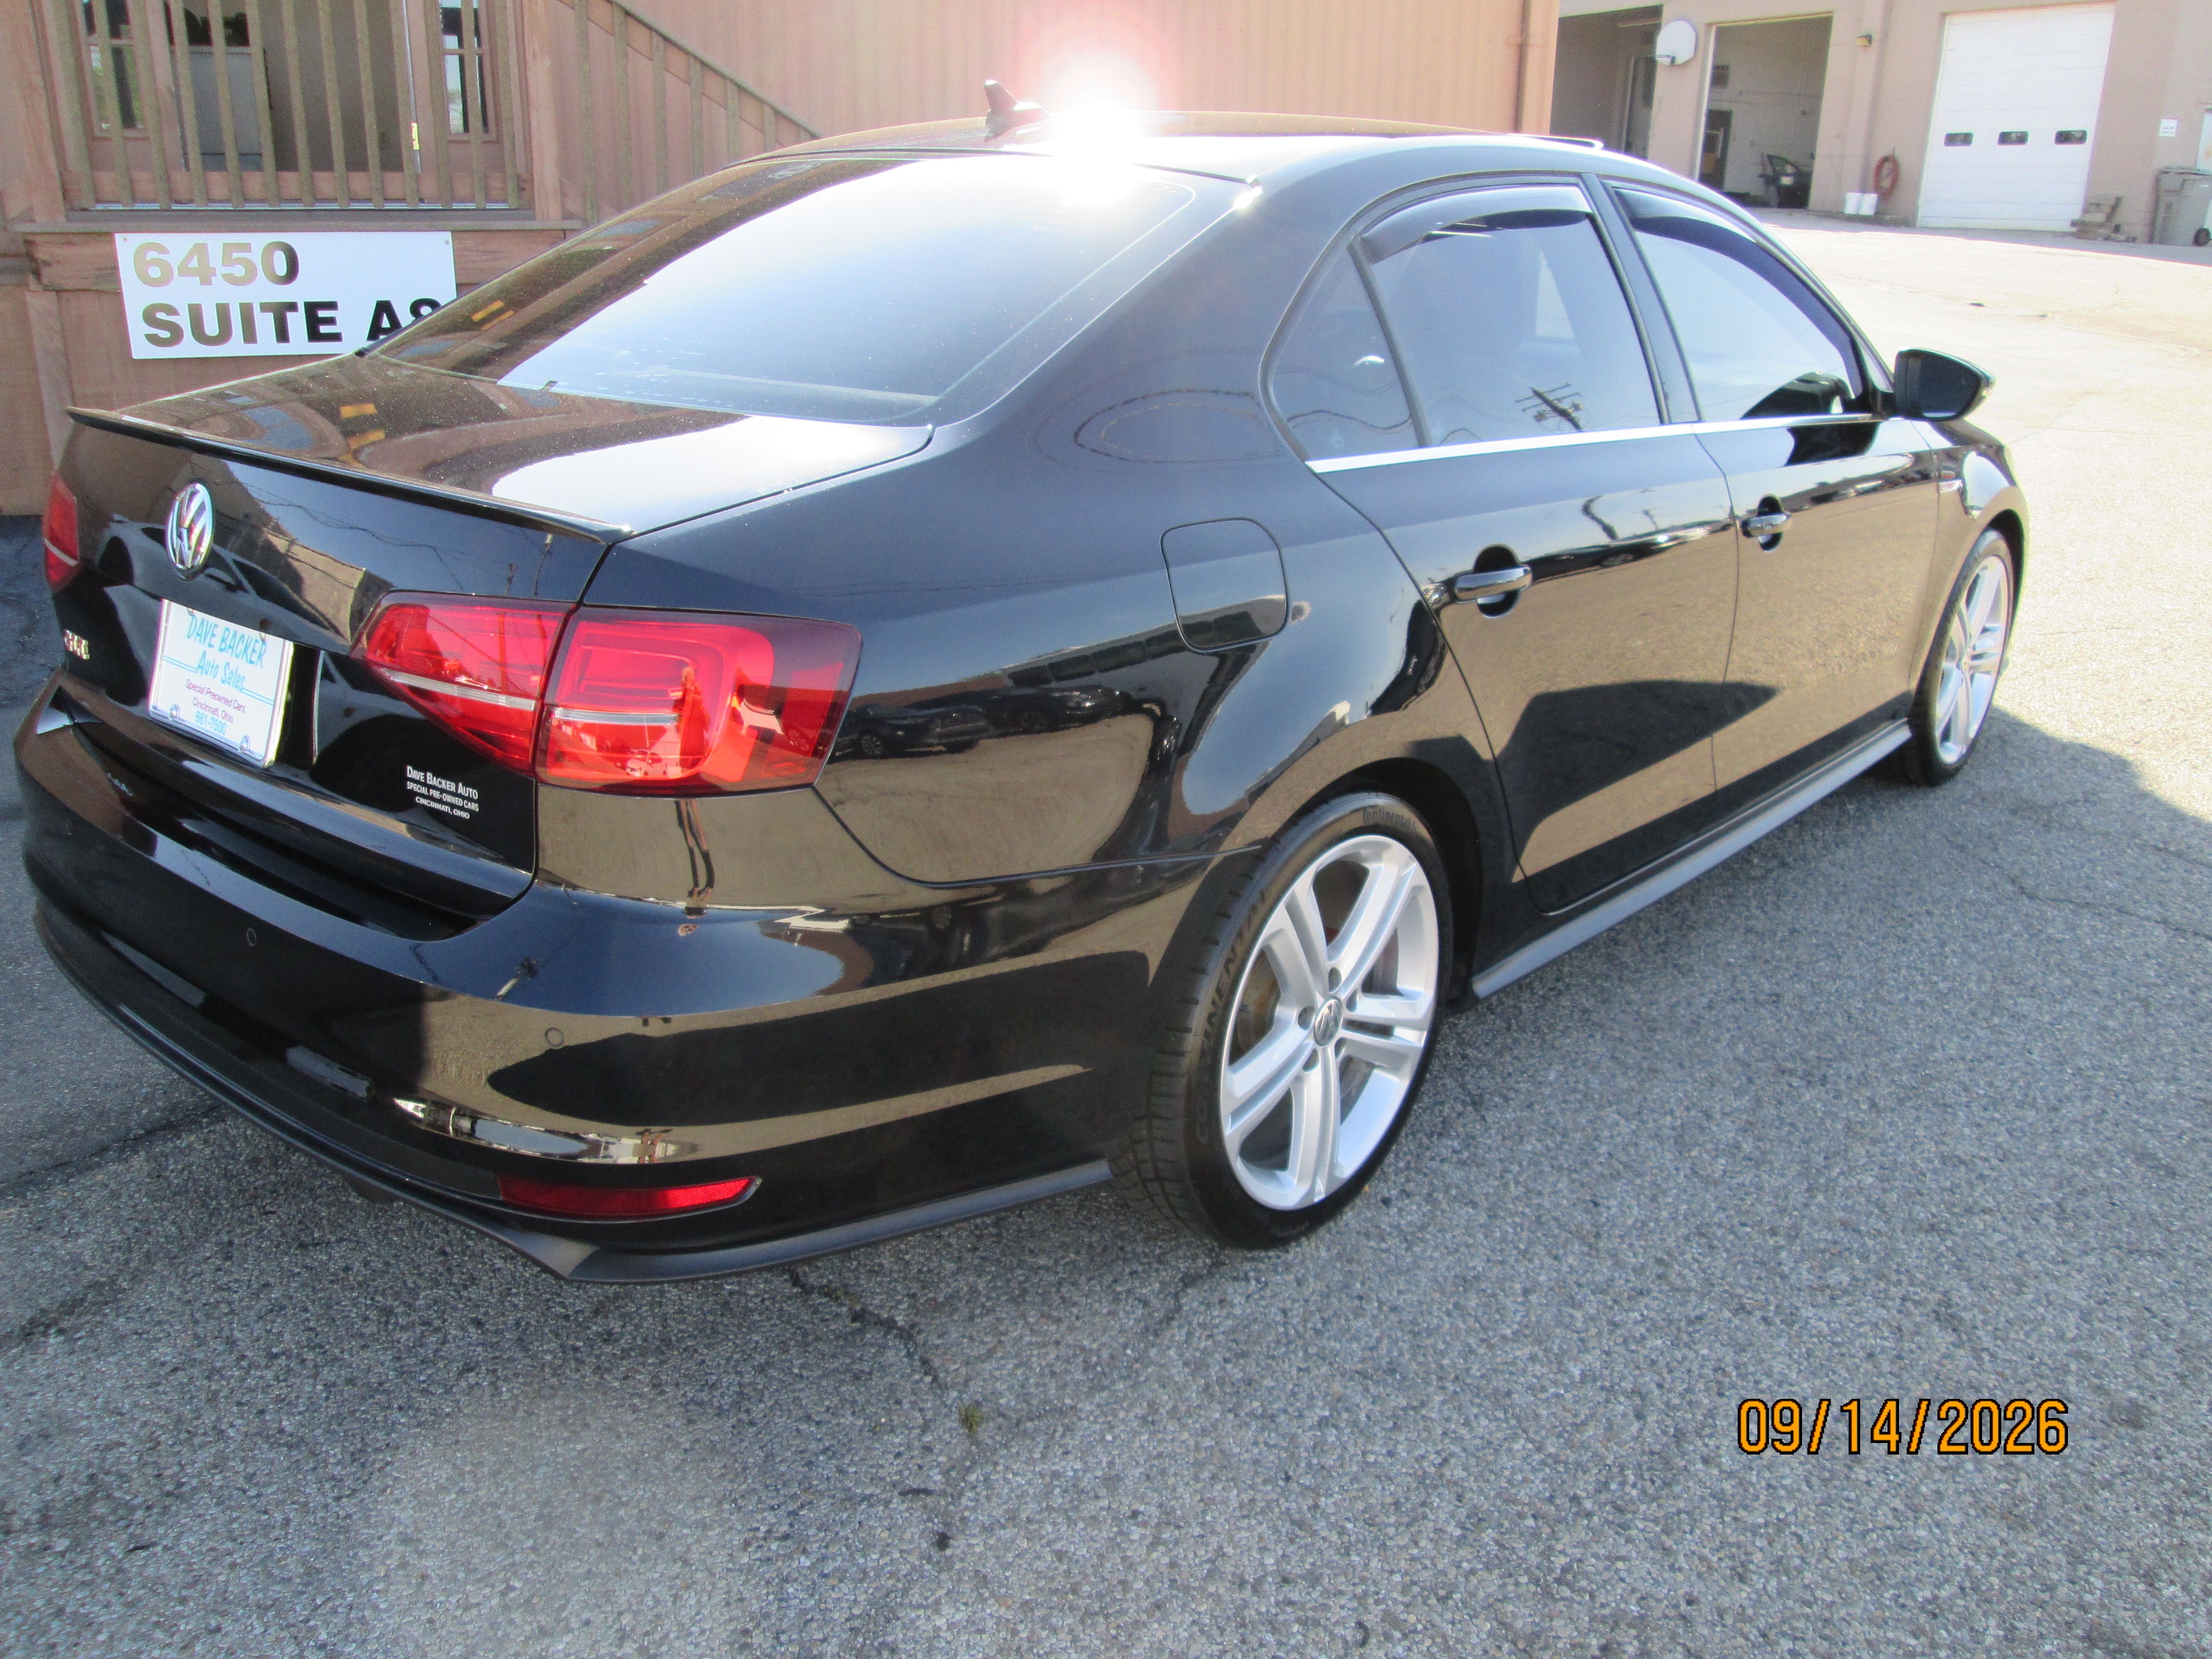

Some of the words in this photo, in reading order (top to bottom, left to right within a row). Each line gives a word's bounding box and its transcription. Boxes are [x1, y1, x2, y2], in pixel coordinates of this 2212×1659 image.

[133, 240, 300, 288] 6450
[142, 301, 343, 348] SUITE
[187, 615, 218, 648] DAVE
[219, 626, 267, 669] BACKER
[197, 650, 219, 679] Auto
[221, 661, 246, 691] Sales
[185, 678, 206, 695] Special
[205, 687, 233, 707] Preowned
[233, 699, 246, 713] Cars
[195, 710, 227, 735] 661-7500
[221, 709, 234, 723] Ohio
[407, 781, 429, 795] SPECIAL
[463, 800, 479, 812] CARS
[415, 796, 452, 815] CINCINNATI,
[453, 808, 470, 819] OHIO
